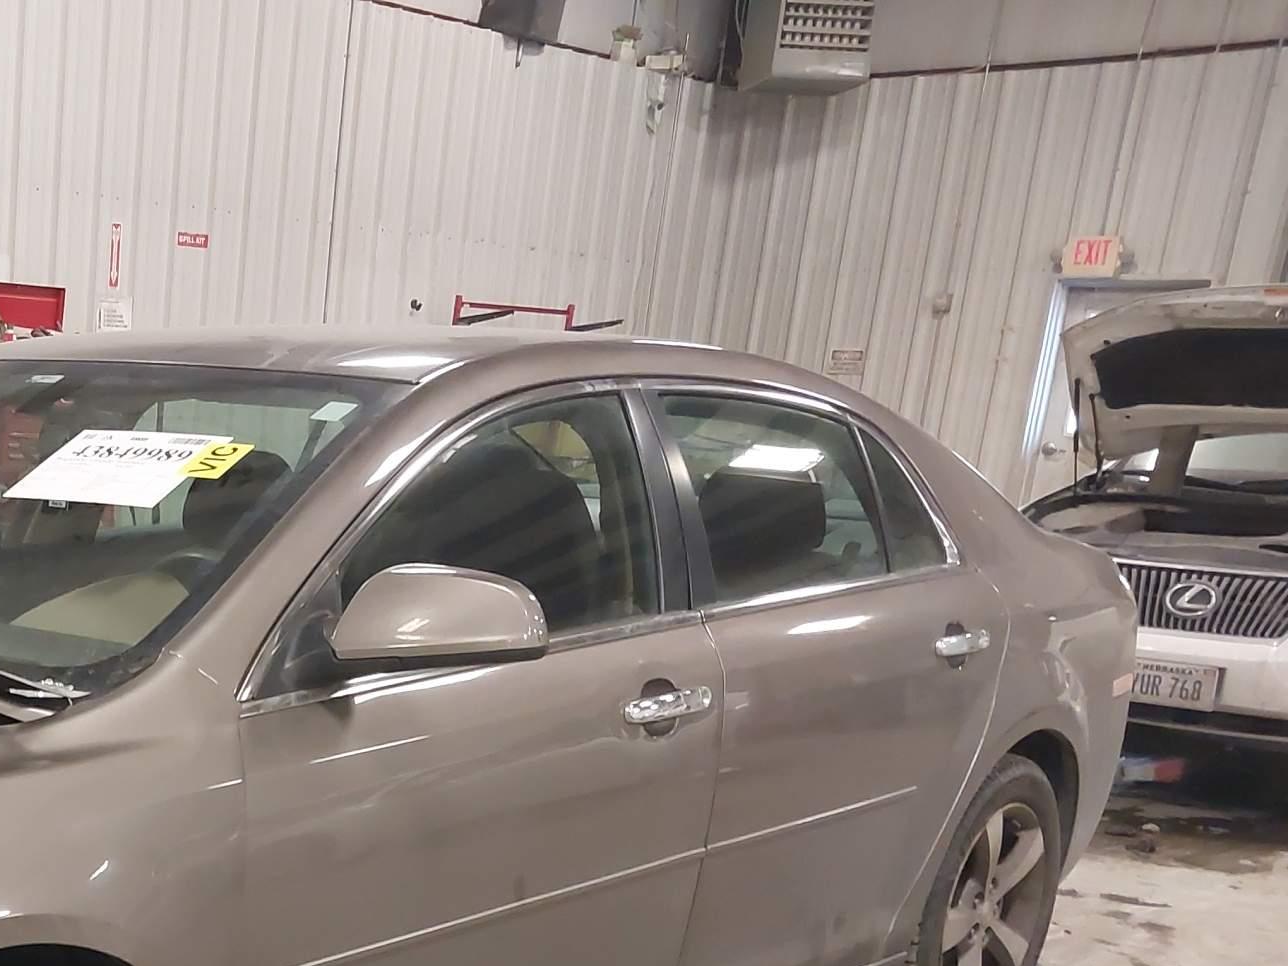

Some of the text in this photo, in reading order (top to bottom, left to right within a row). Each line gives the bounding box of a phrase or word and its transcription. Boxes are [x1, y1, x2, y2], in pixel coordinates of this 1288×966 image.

[178, 235, 195, 244] SPILL
[1073, 239, 1112, 266] EXIT
[72, 445, 192, 462] 43849989
[188, 446, 238, 473] VIC
[1142, 663, 1194, 675] NEBRASKA
